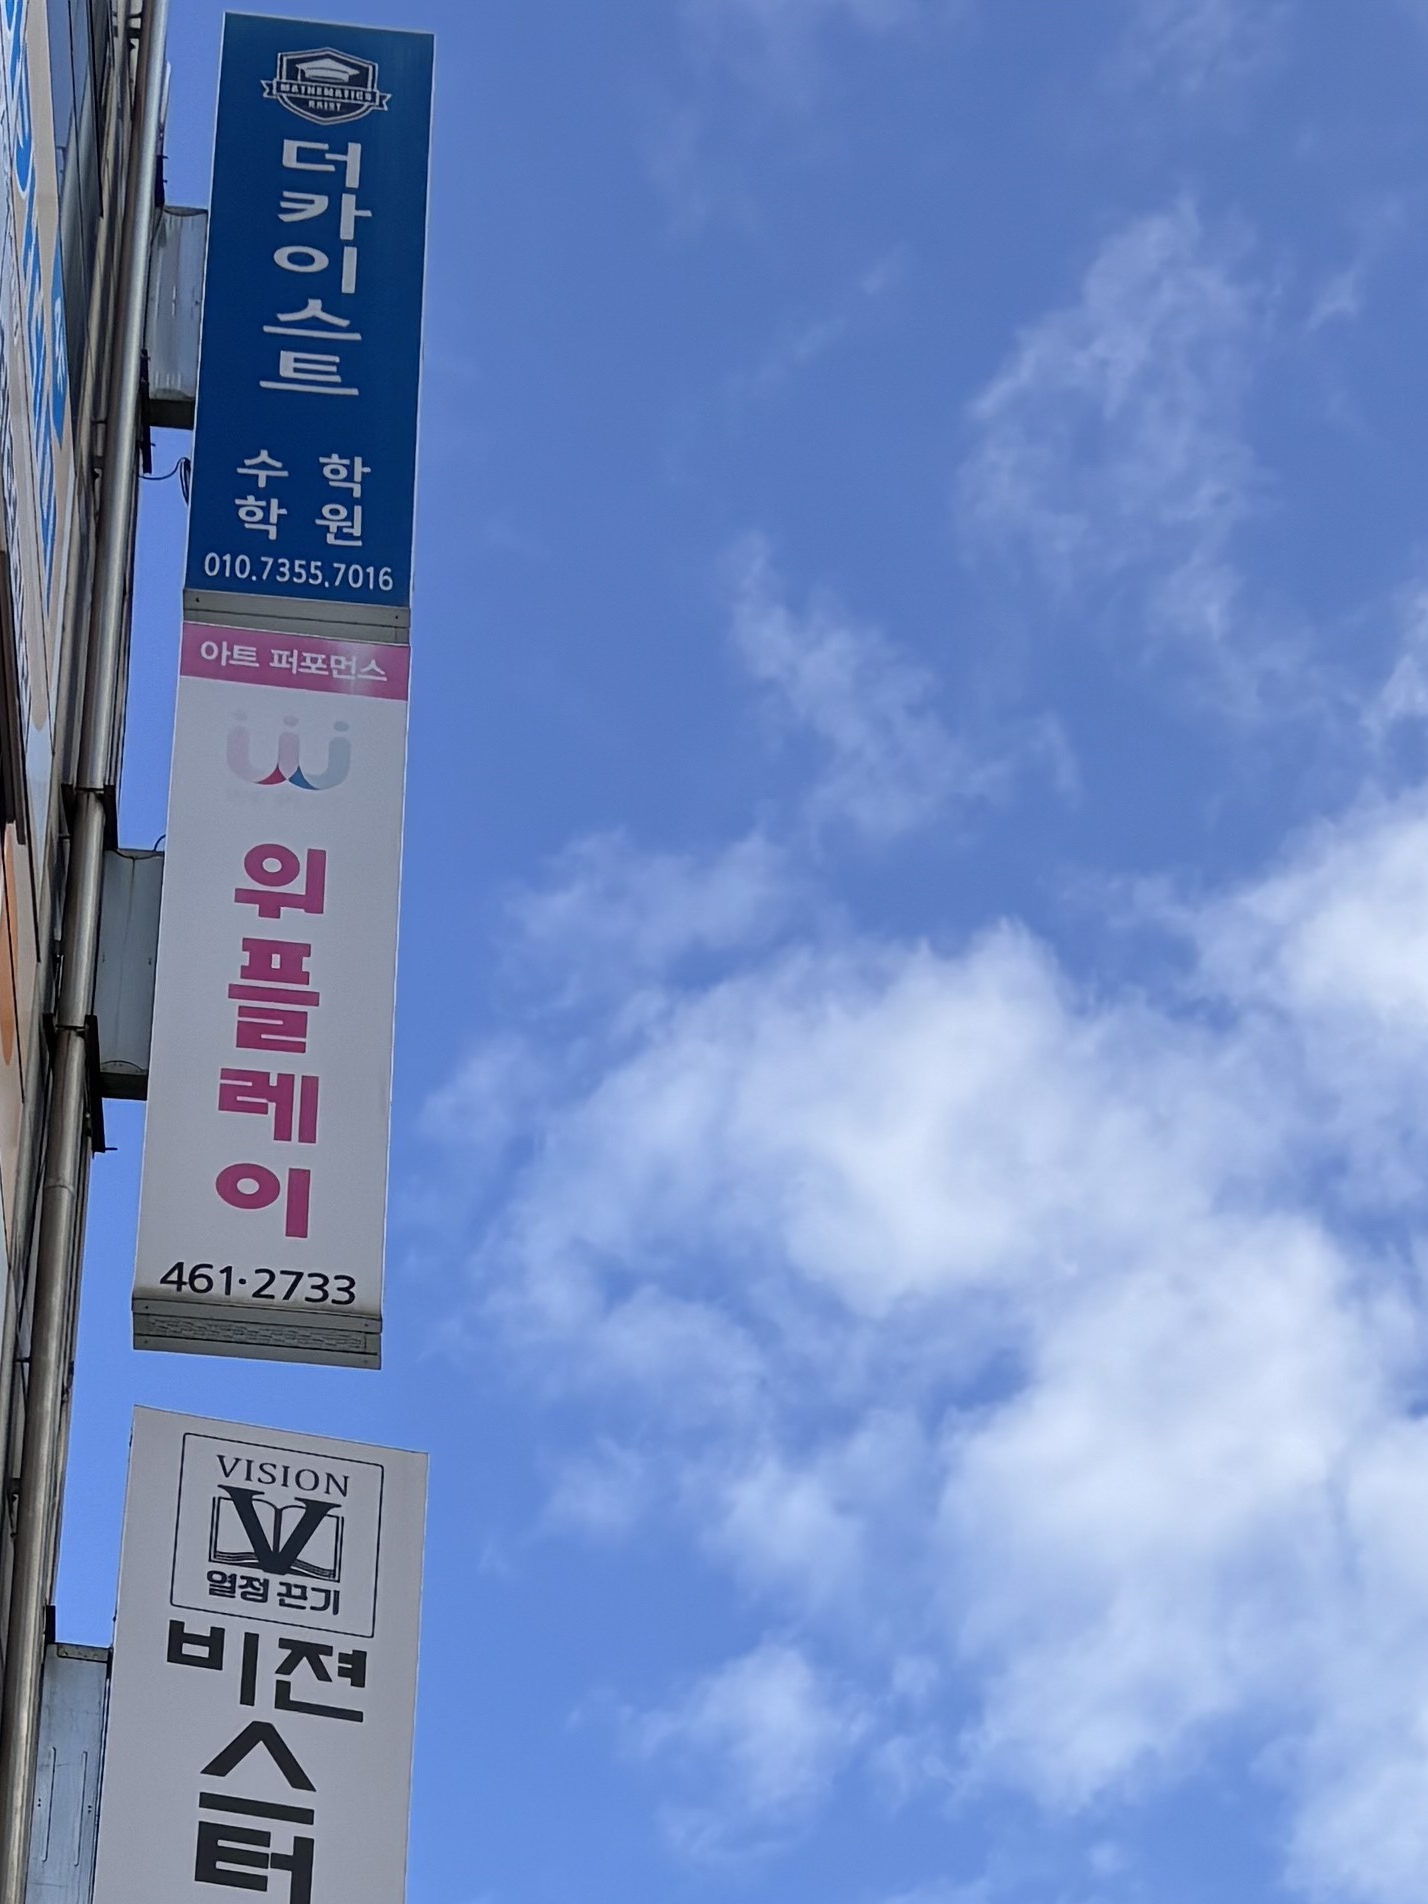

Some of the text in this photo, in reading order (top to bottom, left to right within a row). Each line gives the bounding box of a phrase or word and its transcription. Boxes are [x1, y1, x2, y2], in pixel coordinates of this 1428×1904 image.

[259, 137, 373, 397] 더카이스트
[203, 551, 394, 593] 010.7355.7016
[200, 640, 388, 682] 아트 퍼포먼스
[215, 842, 328, 1240] 위플레이
[215, 1453, 351, 1498] VISION
[206, 1568, 341, 1616] 열정 끈기
